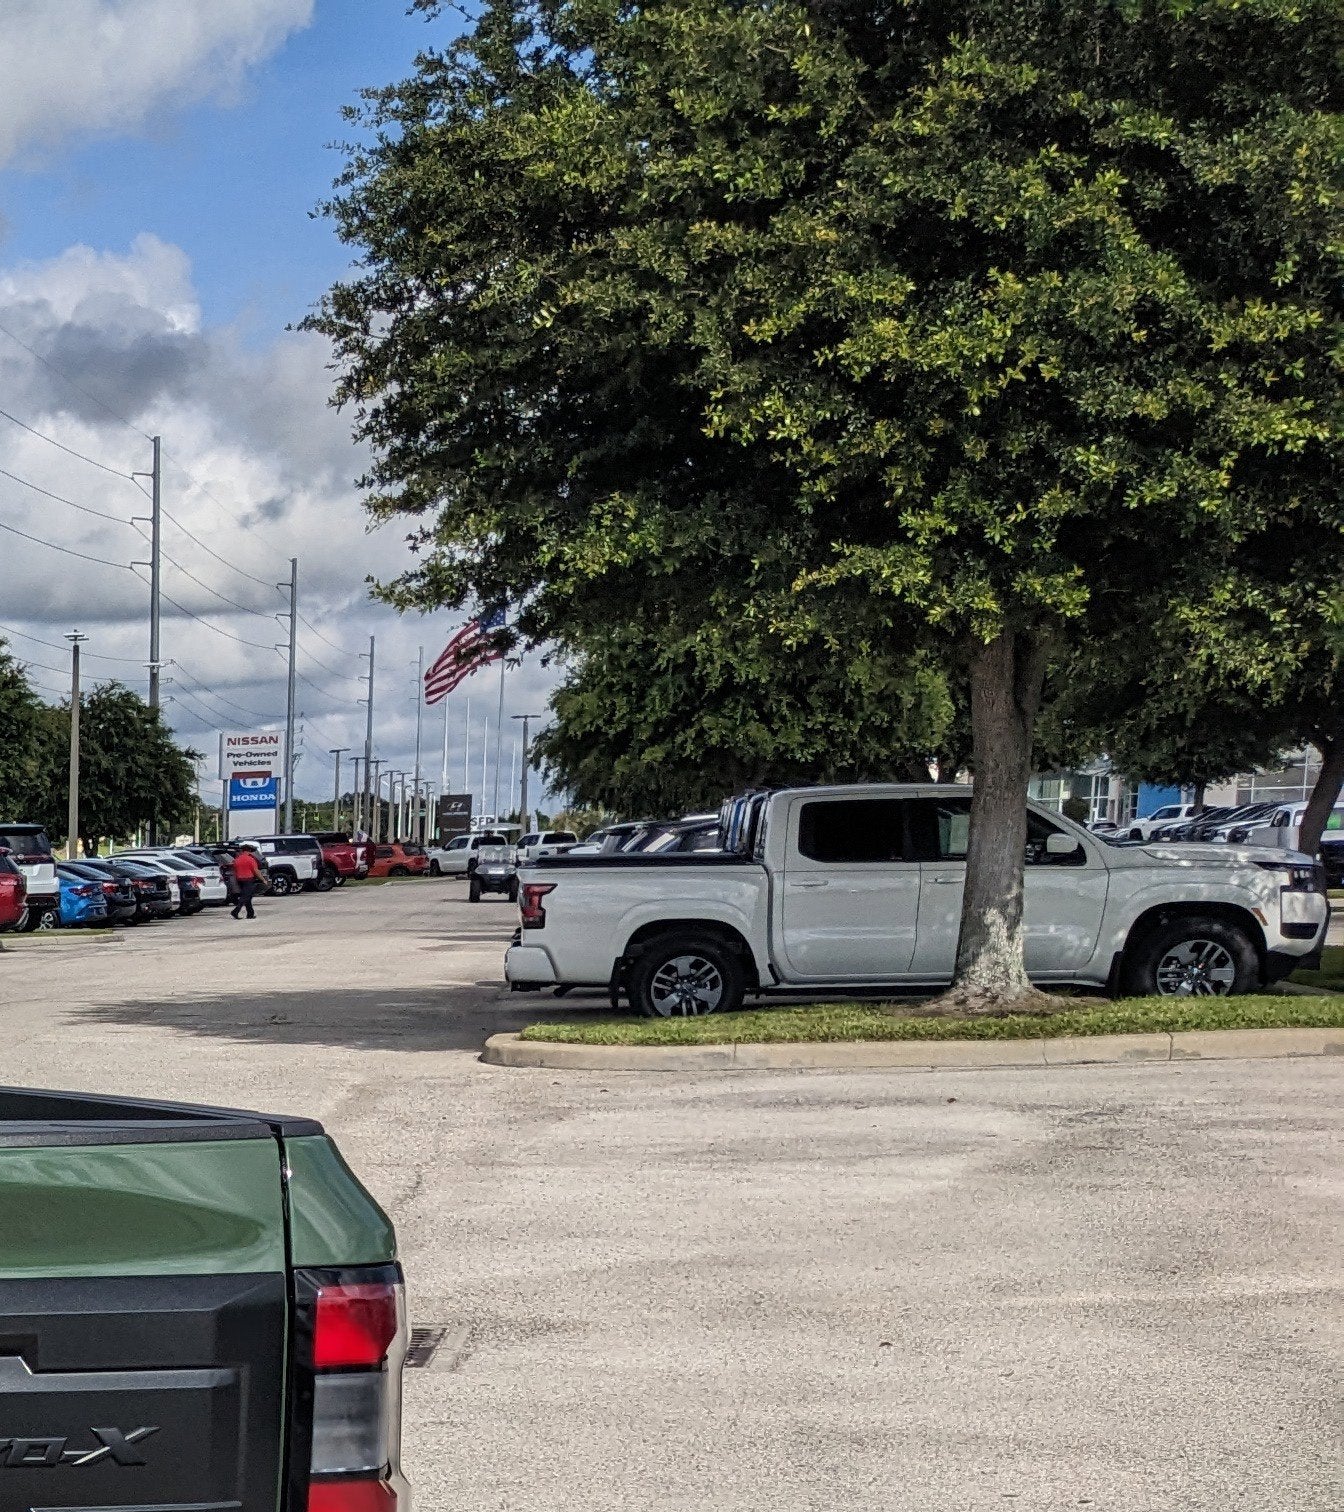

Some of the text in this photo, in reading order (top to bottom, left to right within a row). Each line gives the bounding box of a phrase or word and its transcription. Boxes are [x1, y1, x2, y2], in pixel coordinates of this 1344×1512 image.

[227, 735, 279, 746] NISSAN
[233, 759, 272, 767] Vehicles
[232, 793, 276, 802] HONDA
